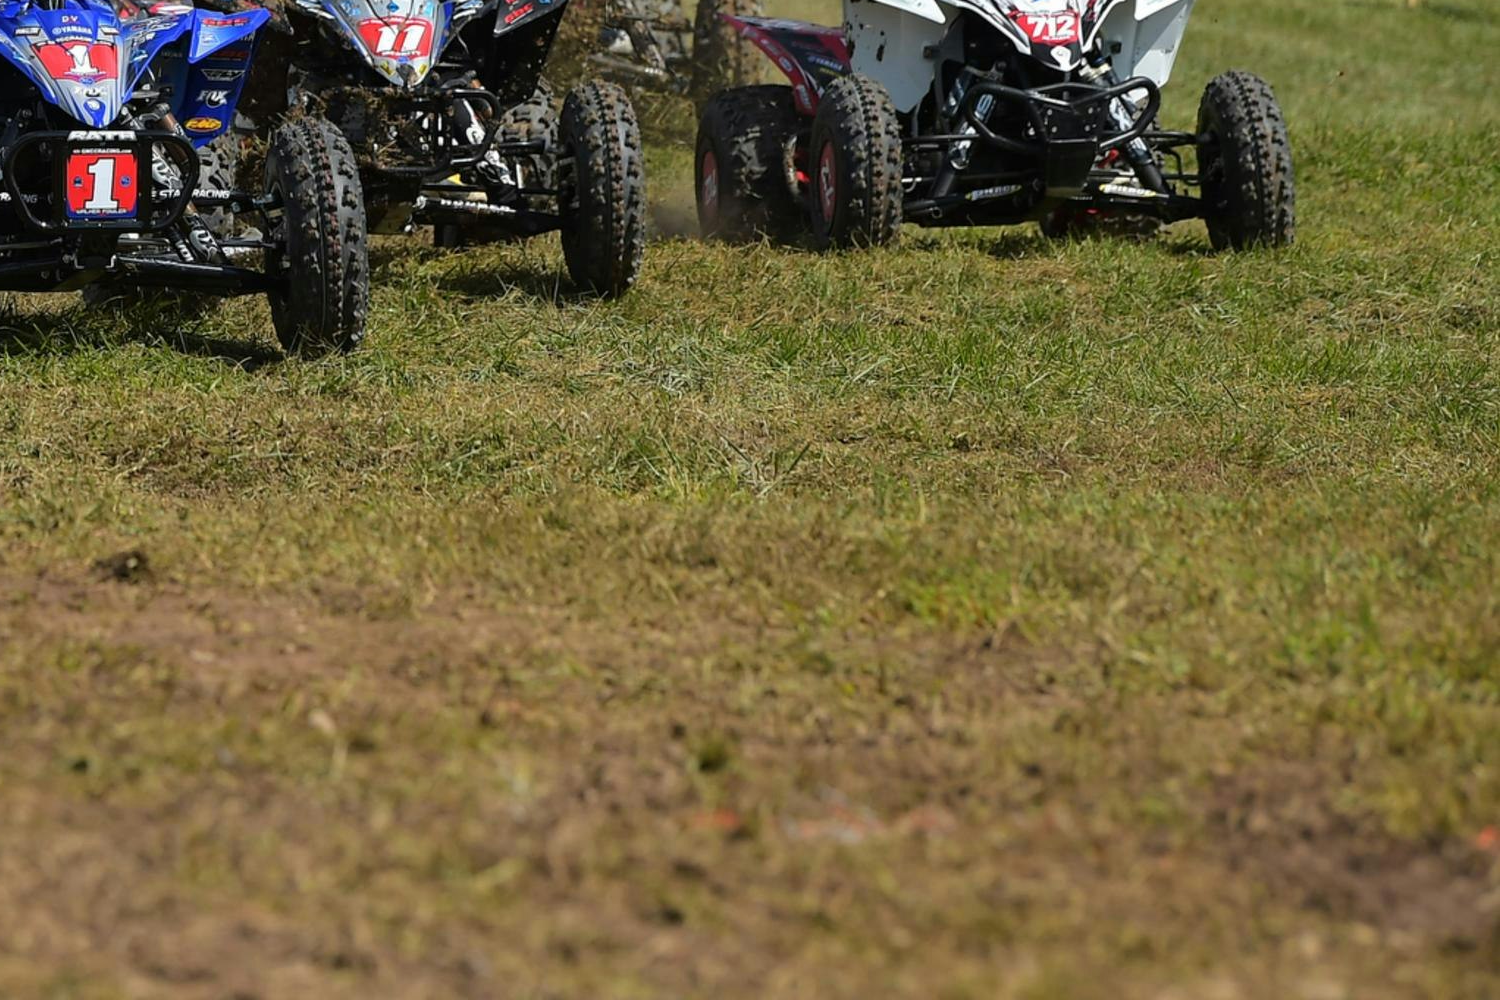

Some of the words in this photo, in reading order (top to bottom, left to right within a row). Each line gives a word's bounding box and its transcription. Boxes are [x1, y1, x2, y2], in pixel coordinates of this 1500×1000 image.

[61, 26, 92, 35] YAMAHA
[1027, 15, 1075, 36] 712
[376, 25, 425, 52] 11
[67, 45, 99, 73] 1
[195, 90, 231, 105] FOX
[84, 158, 118, 209] 1
[192, 189, 231, 199] RACING
